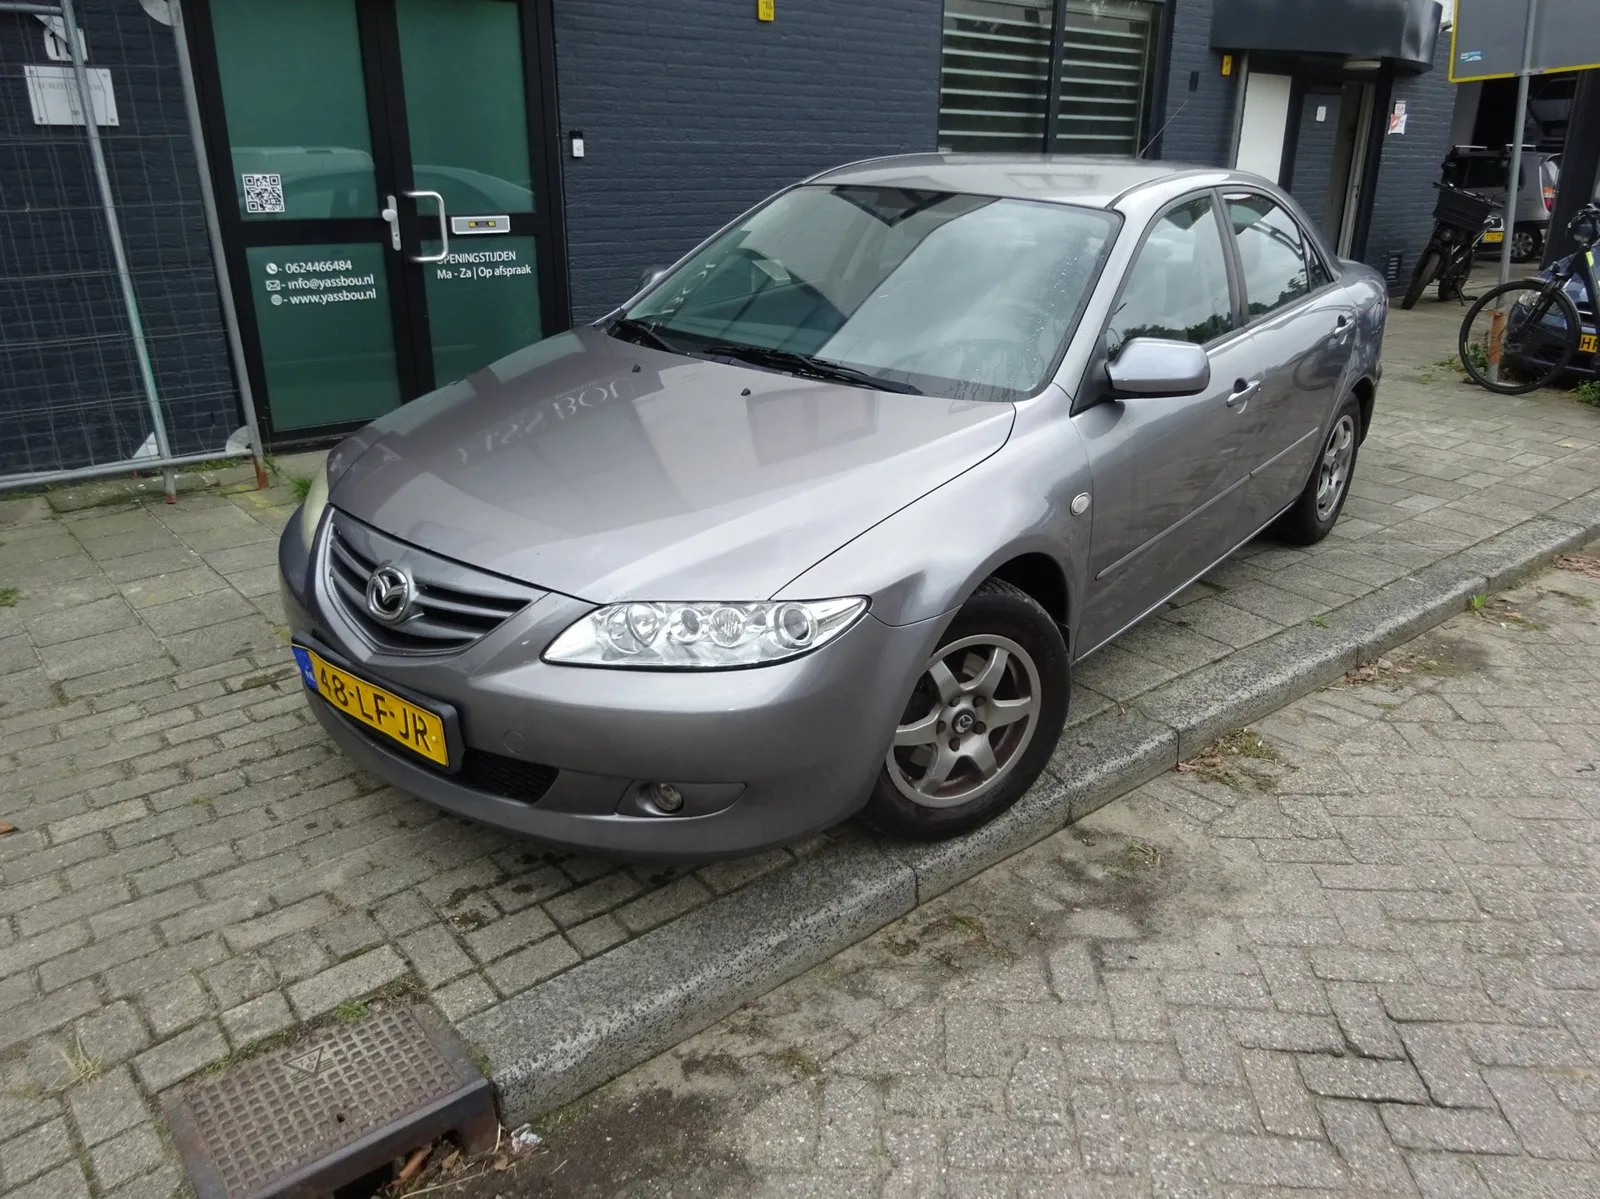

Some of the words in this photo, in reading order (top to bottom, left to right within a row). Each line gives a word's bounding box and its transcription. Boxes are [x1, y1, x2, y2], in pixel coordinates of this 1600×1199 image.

[285, 259, 353, 274] 0624466484
[437, 269, 453, 280] Ma
[459, 268, 472, 279] Za
[477, 266, 493, 279] Op
[494, 264, 532, 277] afspraak
[288, 273, 375, 291] info@yassbou.nl
[289, 288, 377, 305] www.yassbou.nl
[320, 667, 432, 752] 48-LF-JR
